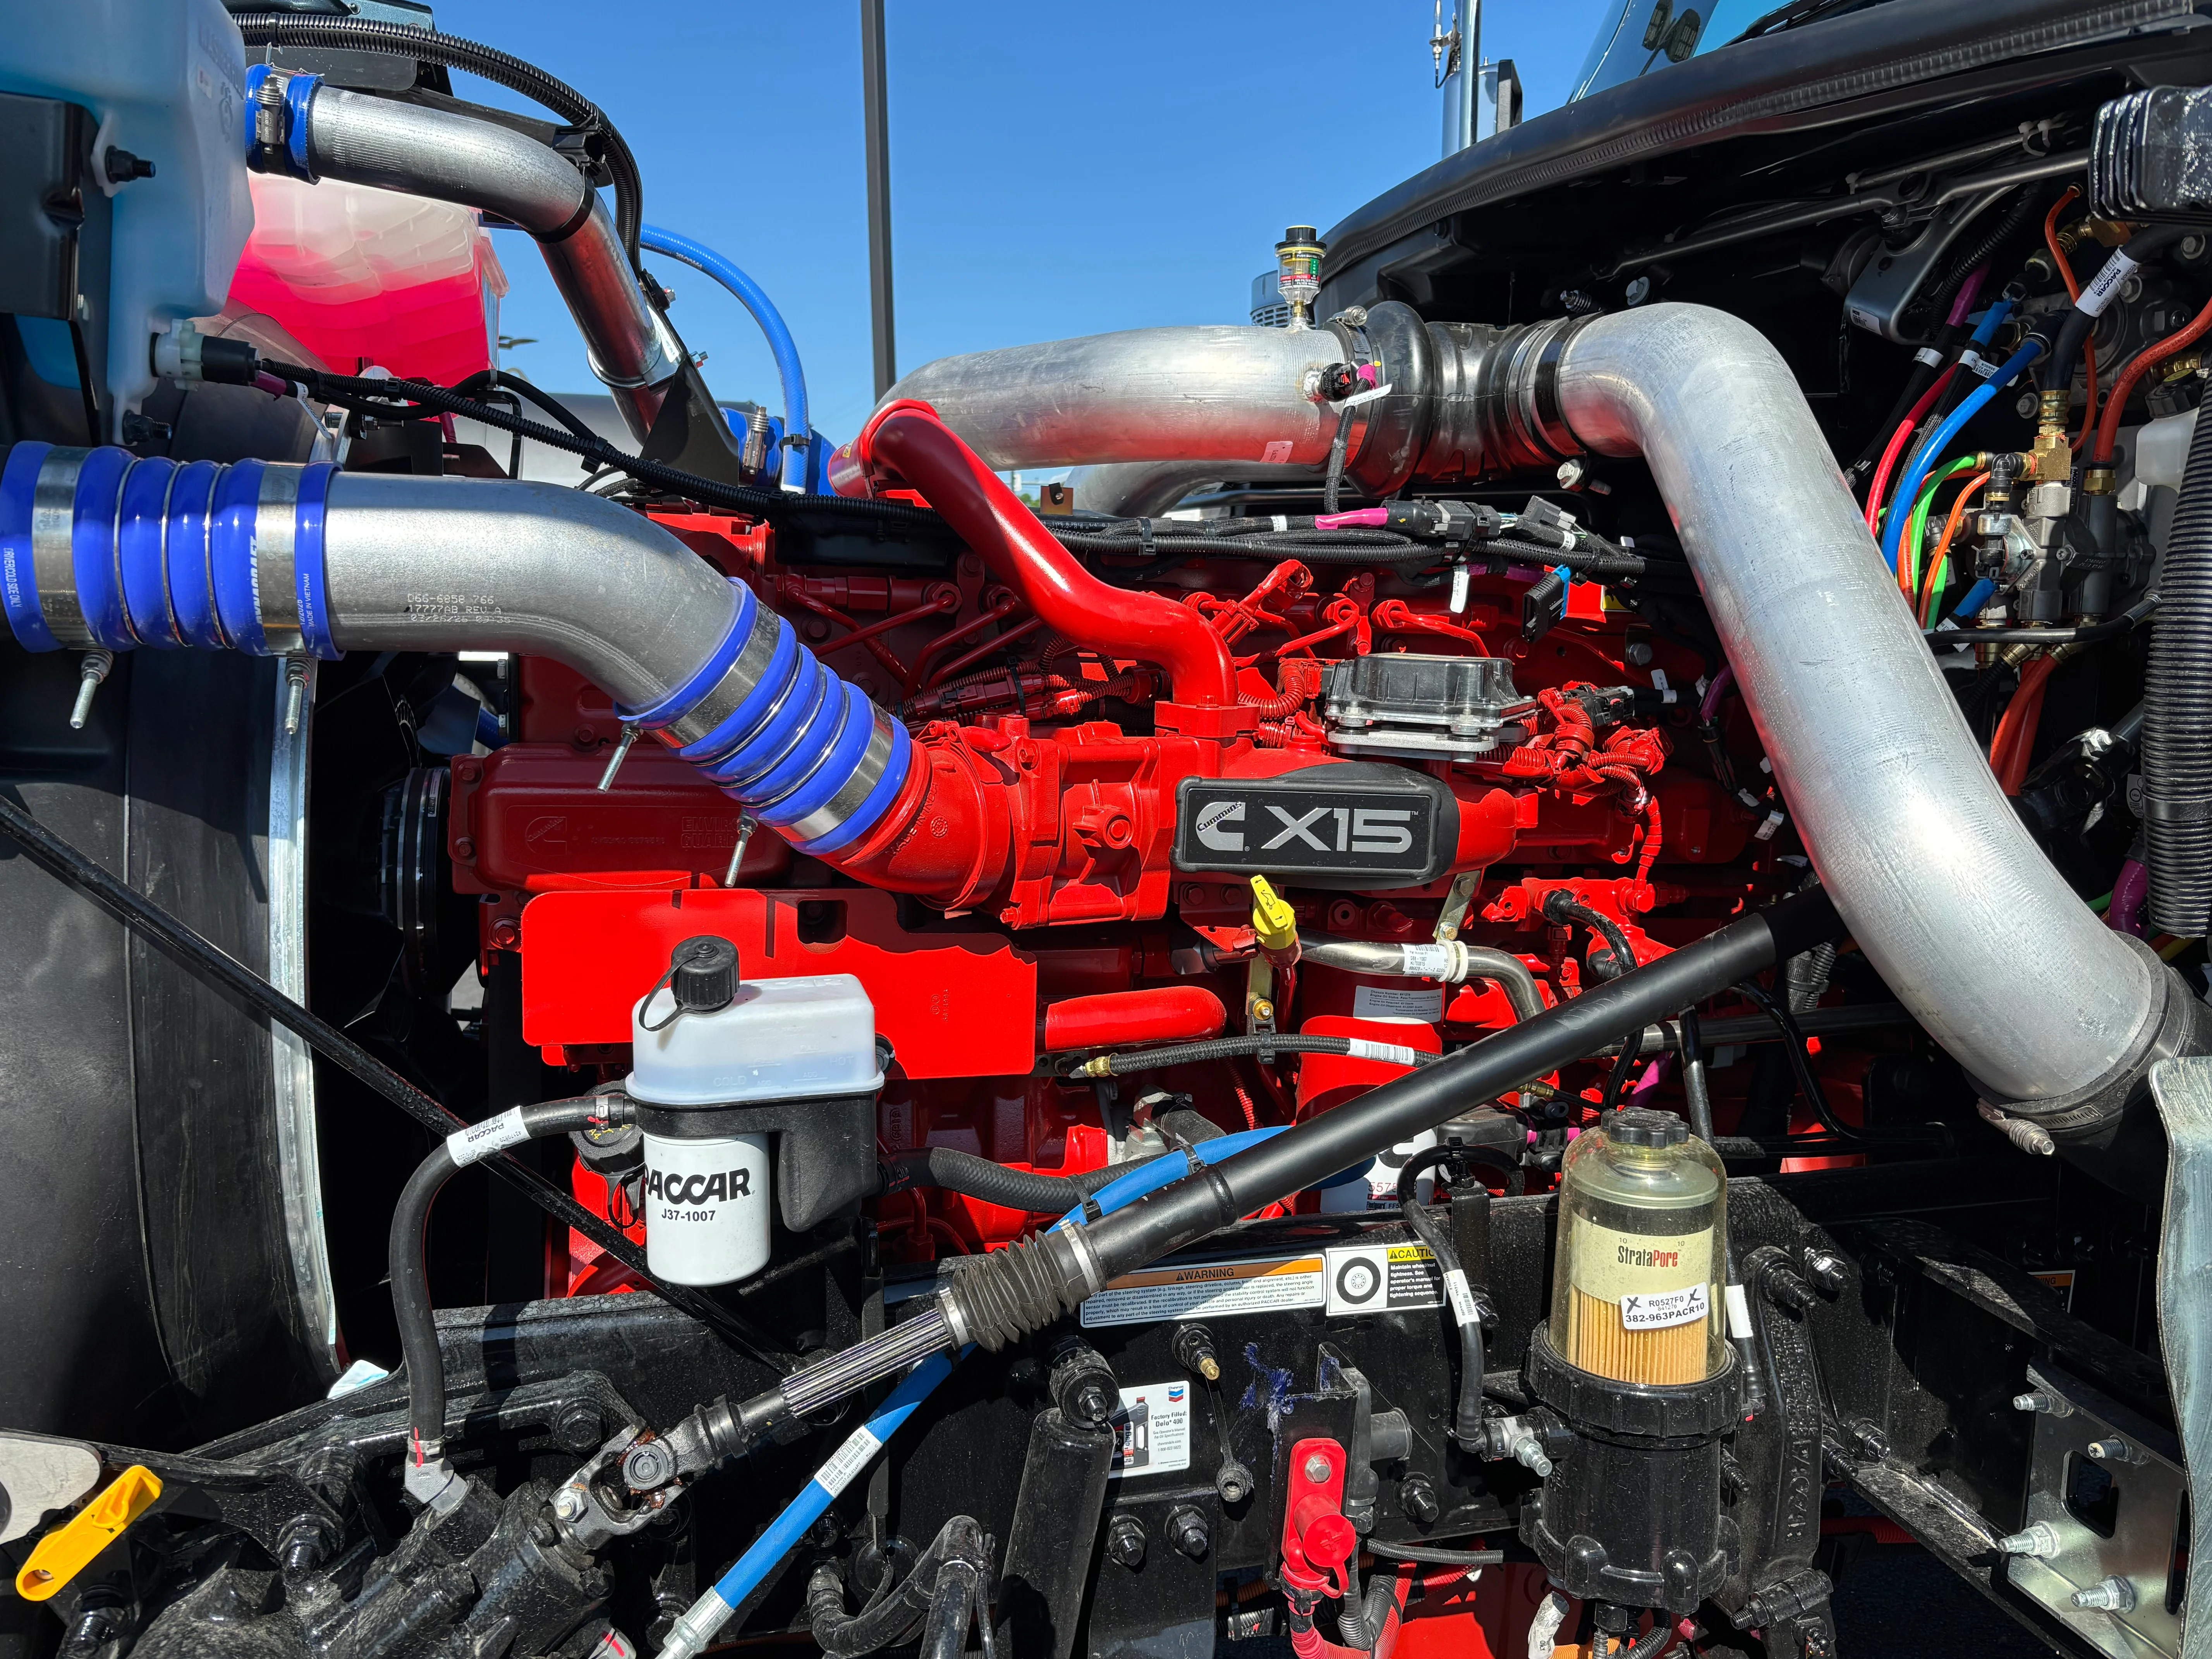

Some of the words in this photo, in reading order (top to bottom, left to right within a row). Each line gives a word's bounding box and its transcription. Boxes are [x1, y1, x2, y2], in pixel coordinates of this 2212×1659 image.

[2096, 268, 2121, 297] PACCAR
[7, 583, 19, 594] SIDE
[9, 595, 22, 608] ONLY
[407, 594, 465, 603] D66-6858
[473, 595, 494, 604] 766
[465, 606, 487, 614] REV
[306, 611, 315, 627] MADE
[923, 783, 938, 813] INDIA
[1197, 801, 1242, 832] Cummins
[1261, 805, 1413, 853] X15
[830, 1056, 854, 1066] HOT
[713, 1075, 747, 1087] COLD
[467, 1123, 505, 1143] PACCAR
[661, 1208, 716, 1221] J37-1007
[1398, 1249, 1434, 1259] CAUTIO
[1618, 1245, 1678, 1267] StrataPore
[1184, 1267, 1234, 1280] WARNING
[1626, 1302, 1704, 1322] 382-963PACR10
